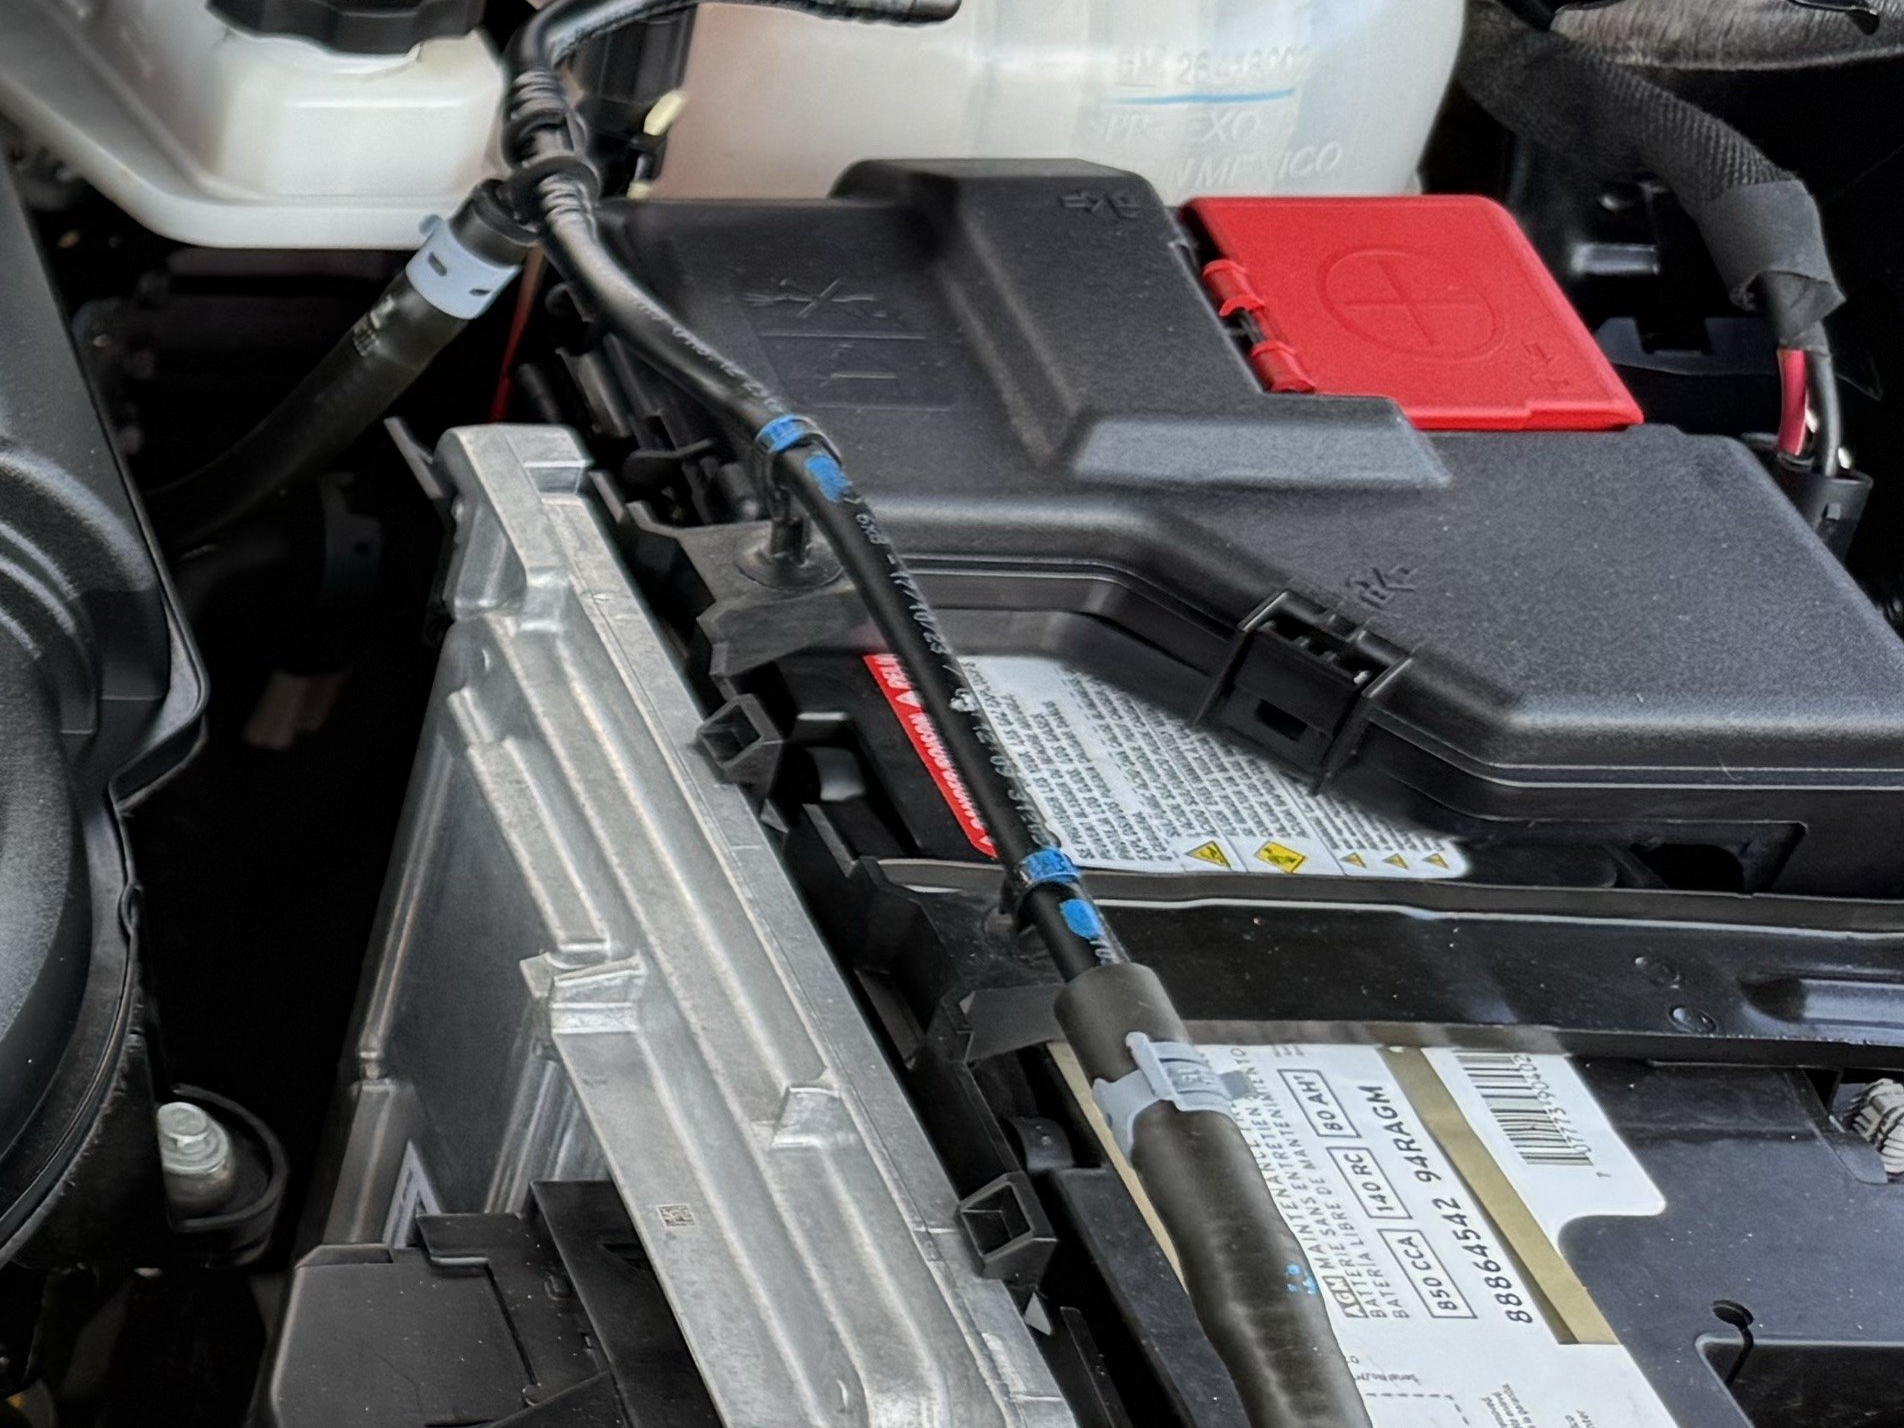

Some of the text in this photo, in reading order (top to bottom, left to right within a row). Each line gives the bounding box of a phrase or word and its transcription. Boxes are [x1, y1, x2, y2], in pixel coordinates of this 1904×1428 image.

[1230, 1048, 1316, 1170] MANTENIMIENTO
[1316, 1110, 1343, 1131] 80
[1243, 1107, 1308, 1190] ENTRETIEN
[1309, 1177, 1332, 1195] DE
[1343, 1153, 1394, 1211] 140 RC
[1355, 1085, 1534, 1324] 88864542 94RAGM
[1300, 1197, 1337, 1236] SANS
[1325, 1203, 1364, 1246] LIBRE
[1323, 1276, 1367, 1318] AGM
[1328, 1243, 1387, 1318] BATTERIE
[1397, 1236, 1458, 1310] 850 CCA
